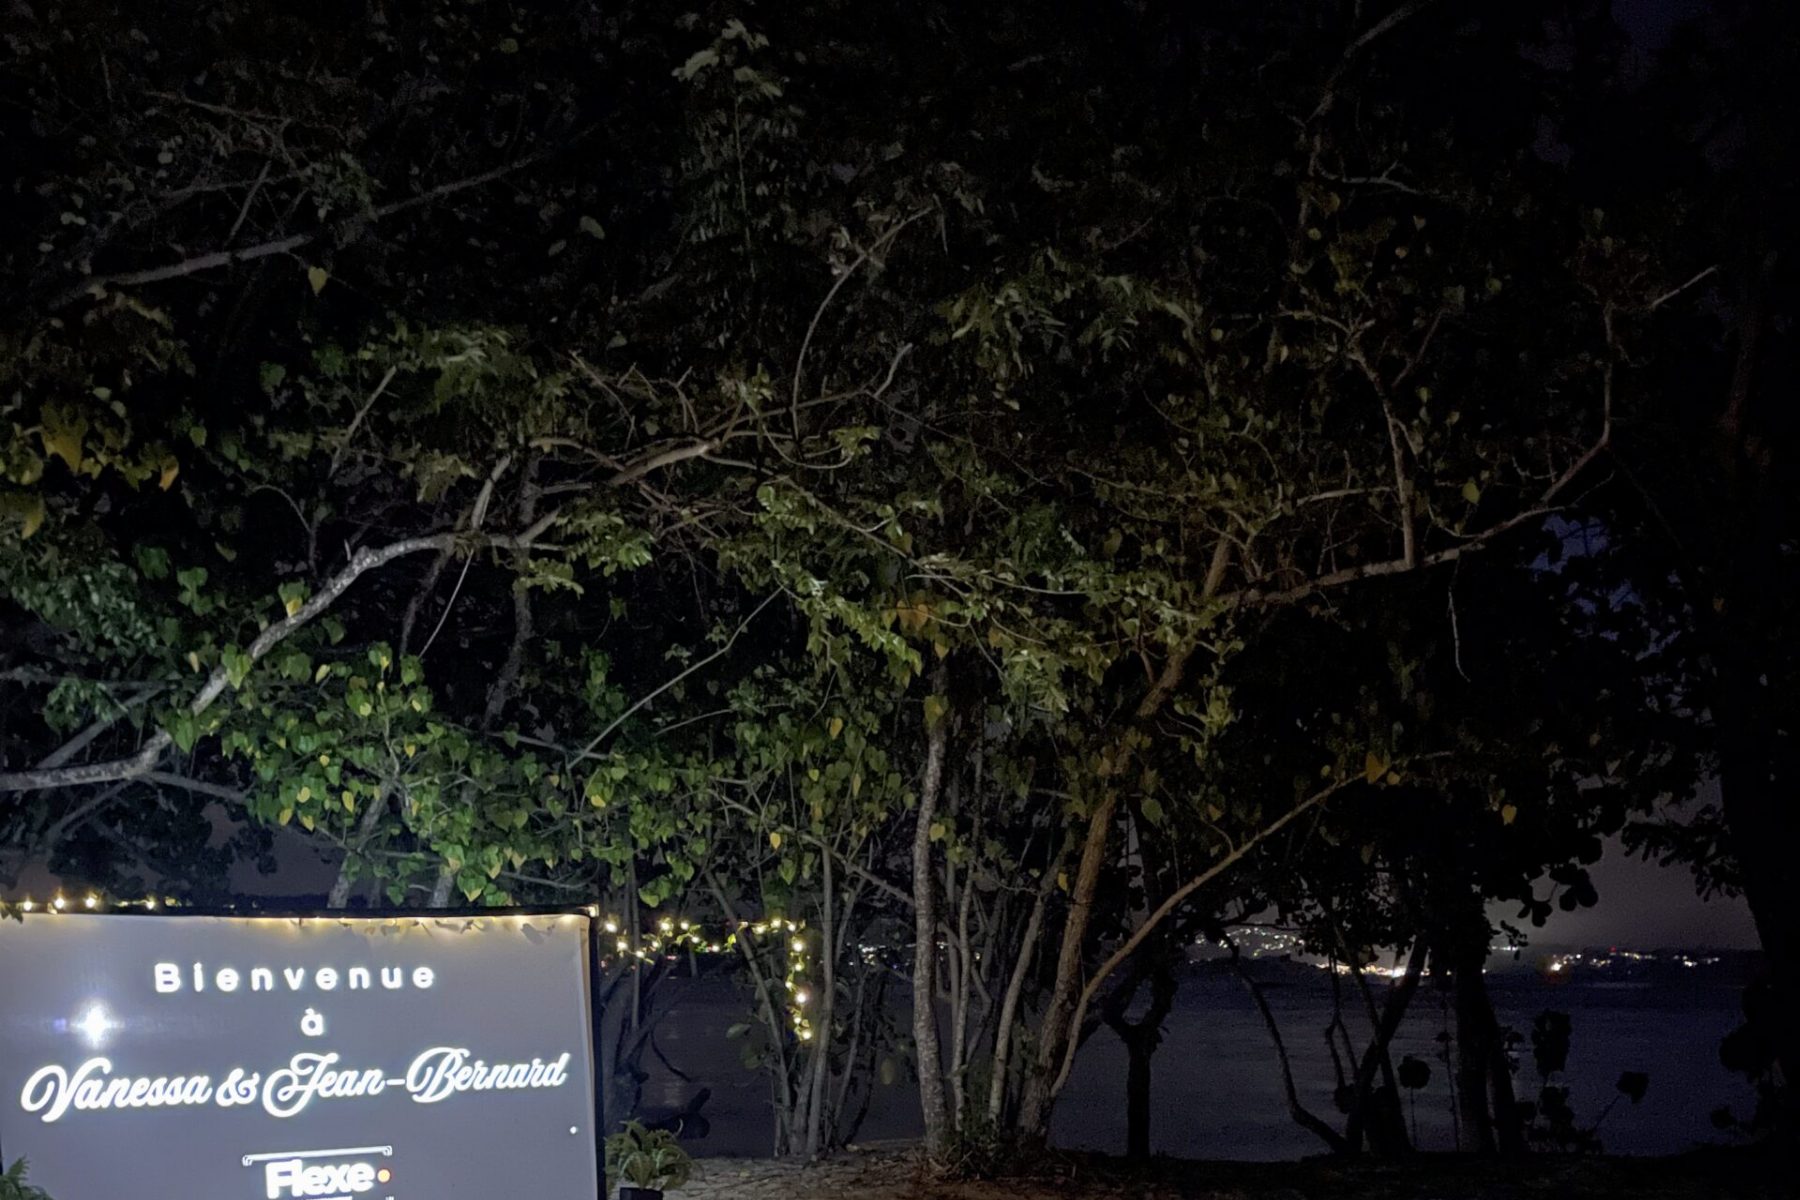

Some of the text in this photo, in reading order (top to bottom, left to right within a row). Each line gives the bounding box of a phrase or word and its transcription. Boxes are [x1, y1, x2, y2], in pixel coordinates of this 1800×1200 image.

[154, 961, 435, 993] Bienvenue
[300, 1007, 325, 1037] à
[20, 1046, 571, 1123] Vanessa & Jean-Bernard
[265, 1158, 376, 1199] Flexe
